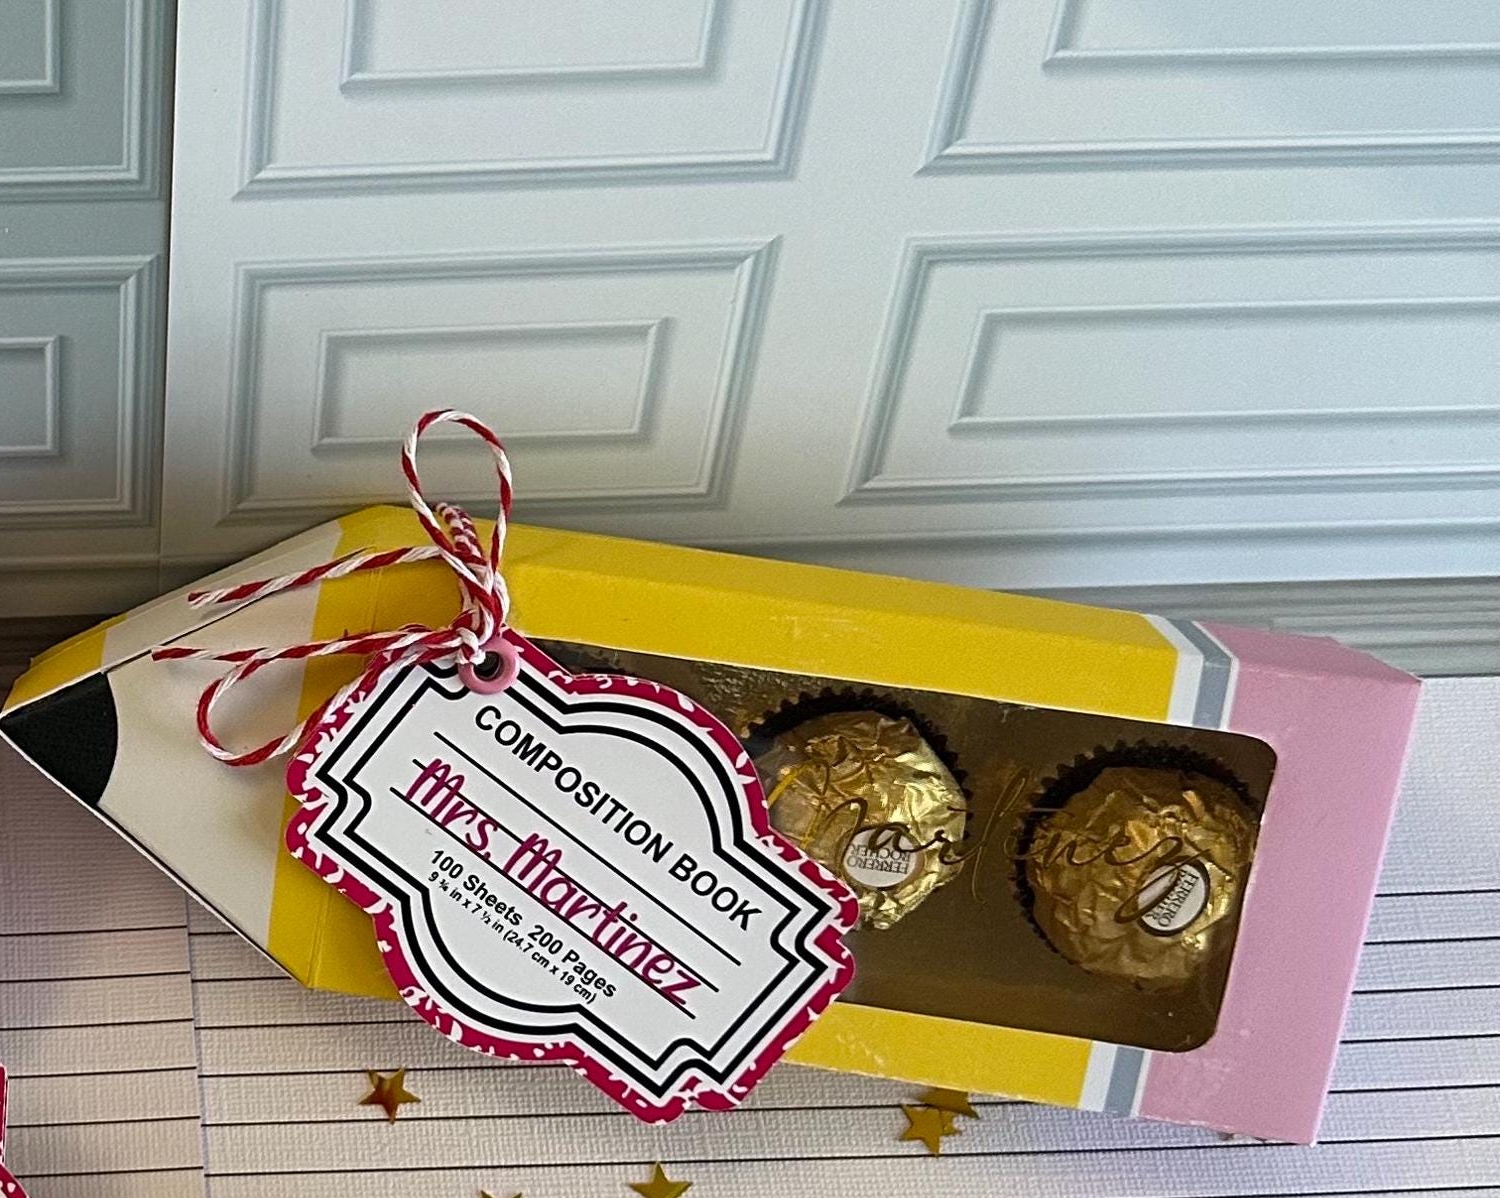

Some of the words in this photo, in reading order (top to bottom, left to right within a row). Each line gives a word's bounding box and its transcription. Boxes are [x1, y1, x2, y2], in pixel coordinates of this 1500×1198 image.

[405, 758, 498, 860] Mrs.
[502, 833, 702, 1005] Martinez
[475, 705, 674, 863] COMPOSITION
[668, 853, 763, 931] BOOK
[846, 856, 910, 875] FERRERO
[428, 871, 439, 882] 9
[449, 888, 463, 903] in
[462, 899, 473, 909] x
[472, 904, 483, 915] 7
[492, 919, 505, 935] in
[502, 929, 534, 953] (24.7
[531, 950, 550, 968] cm
[549, 965, 559, 975] x
[560, 970, 575, 986] 19
[573, 981, 598, 1005] cm)
[431, 850, 464, 879] 100
[463, 874, 523, 926] Sheets
[528, 924, 563, 955] 200
[562, 949, 617, 998] Pages
